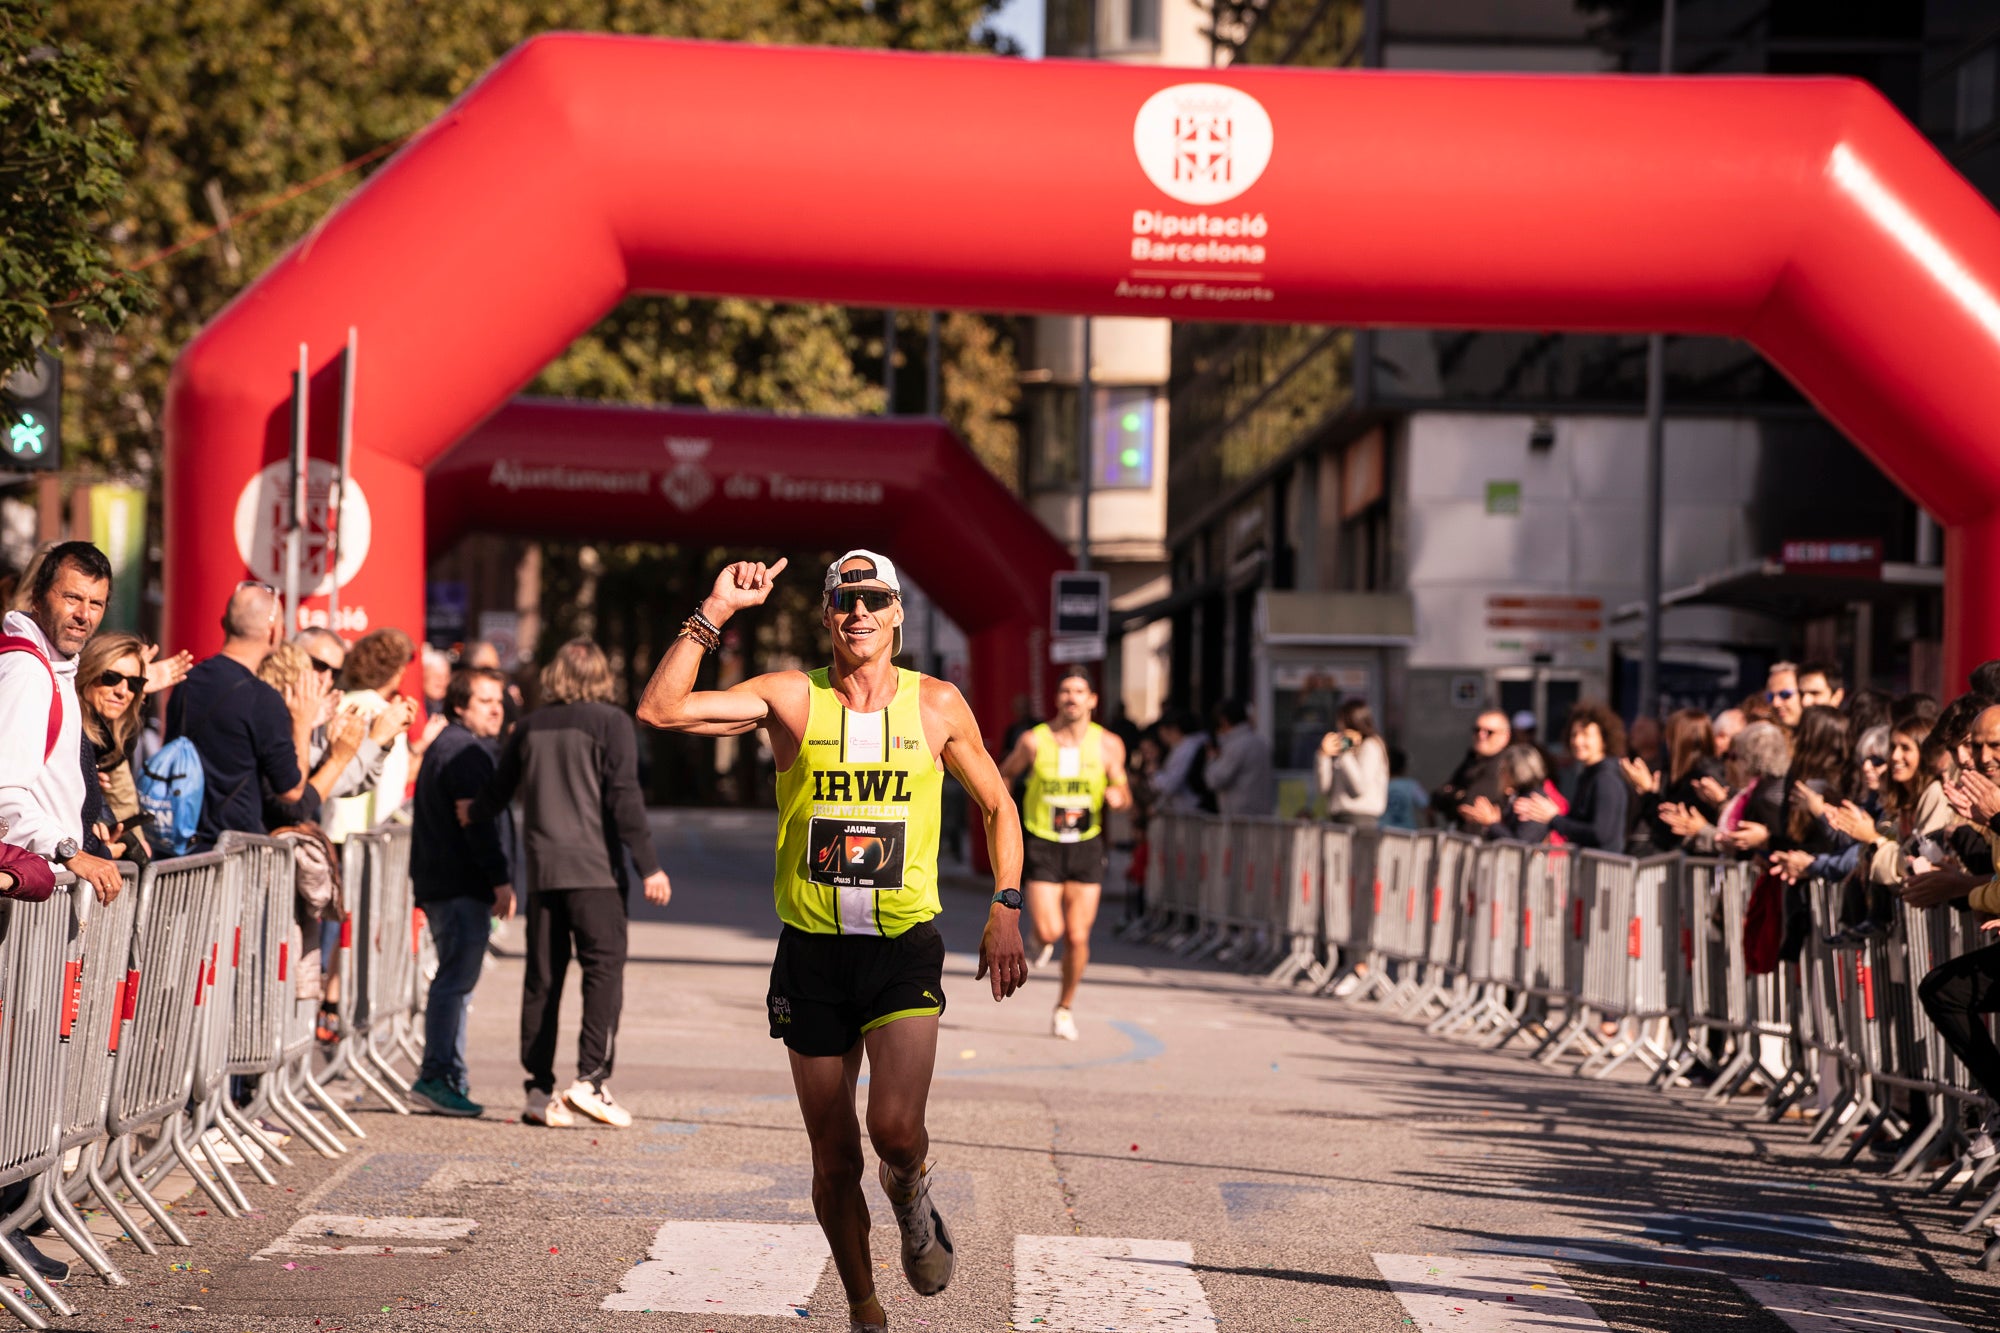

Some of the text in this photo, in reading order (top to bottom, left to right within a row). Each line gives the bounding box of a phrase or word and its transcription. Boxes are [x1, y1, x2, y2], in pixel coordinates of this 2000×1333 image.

[1133, 209, 1268, 239] Diputació
[1131, 237, 1266, 264] Barcelona
[489, 458, 884, 503] Ajuntament de Terrassa
[813, 771, 911, 801] IRWL
[844, 825, 876, 834] JAUME
[851, 846, 865, 864] 2
